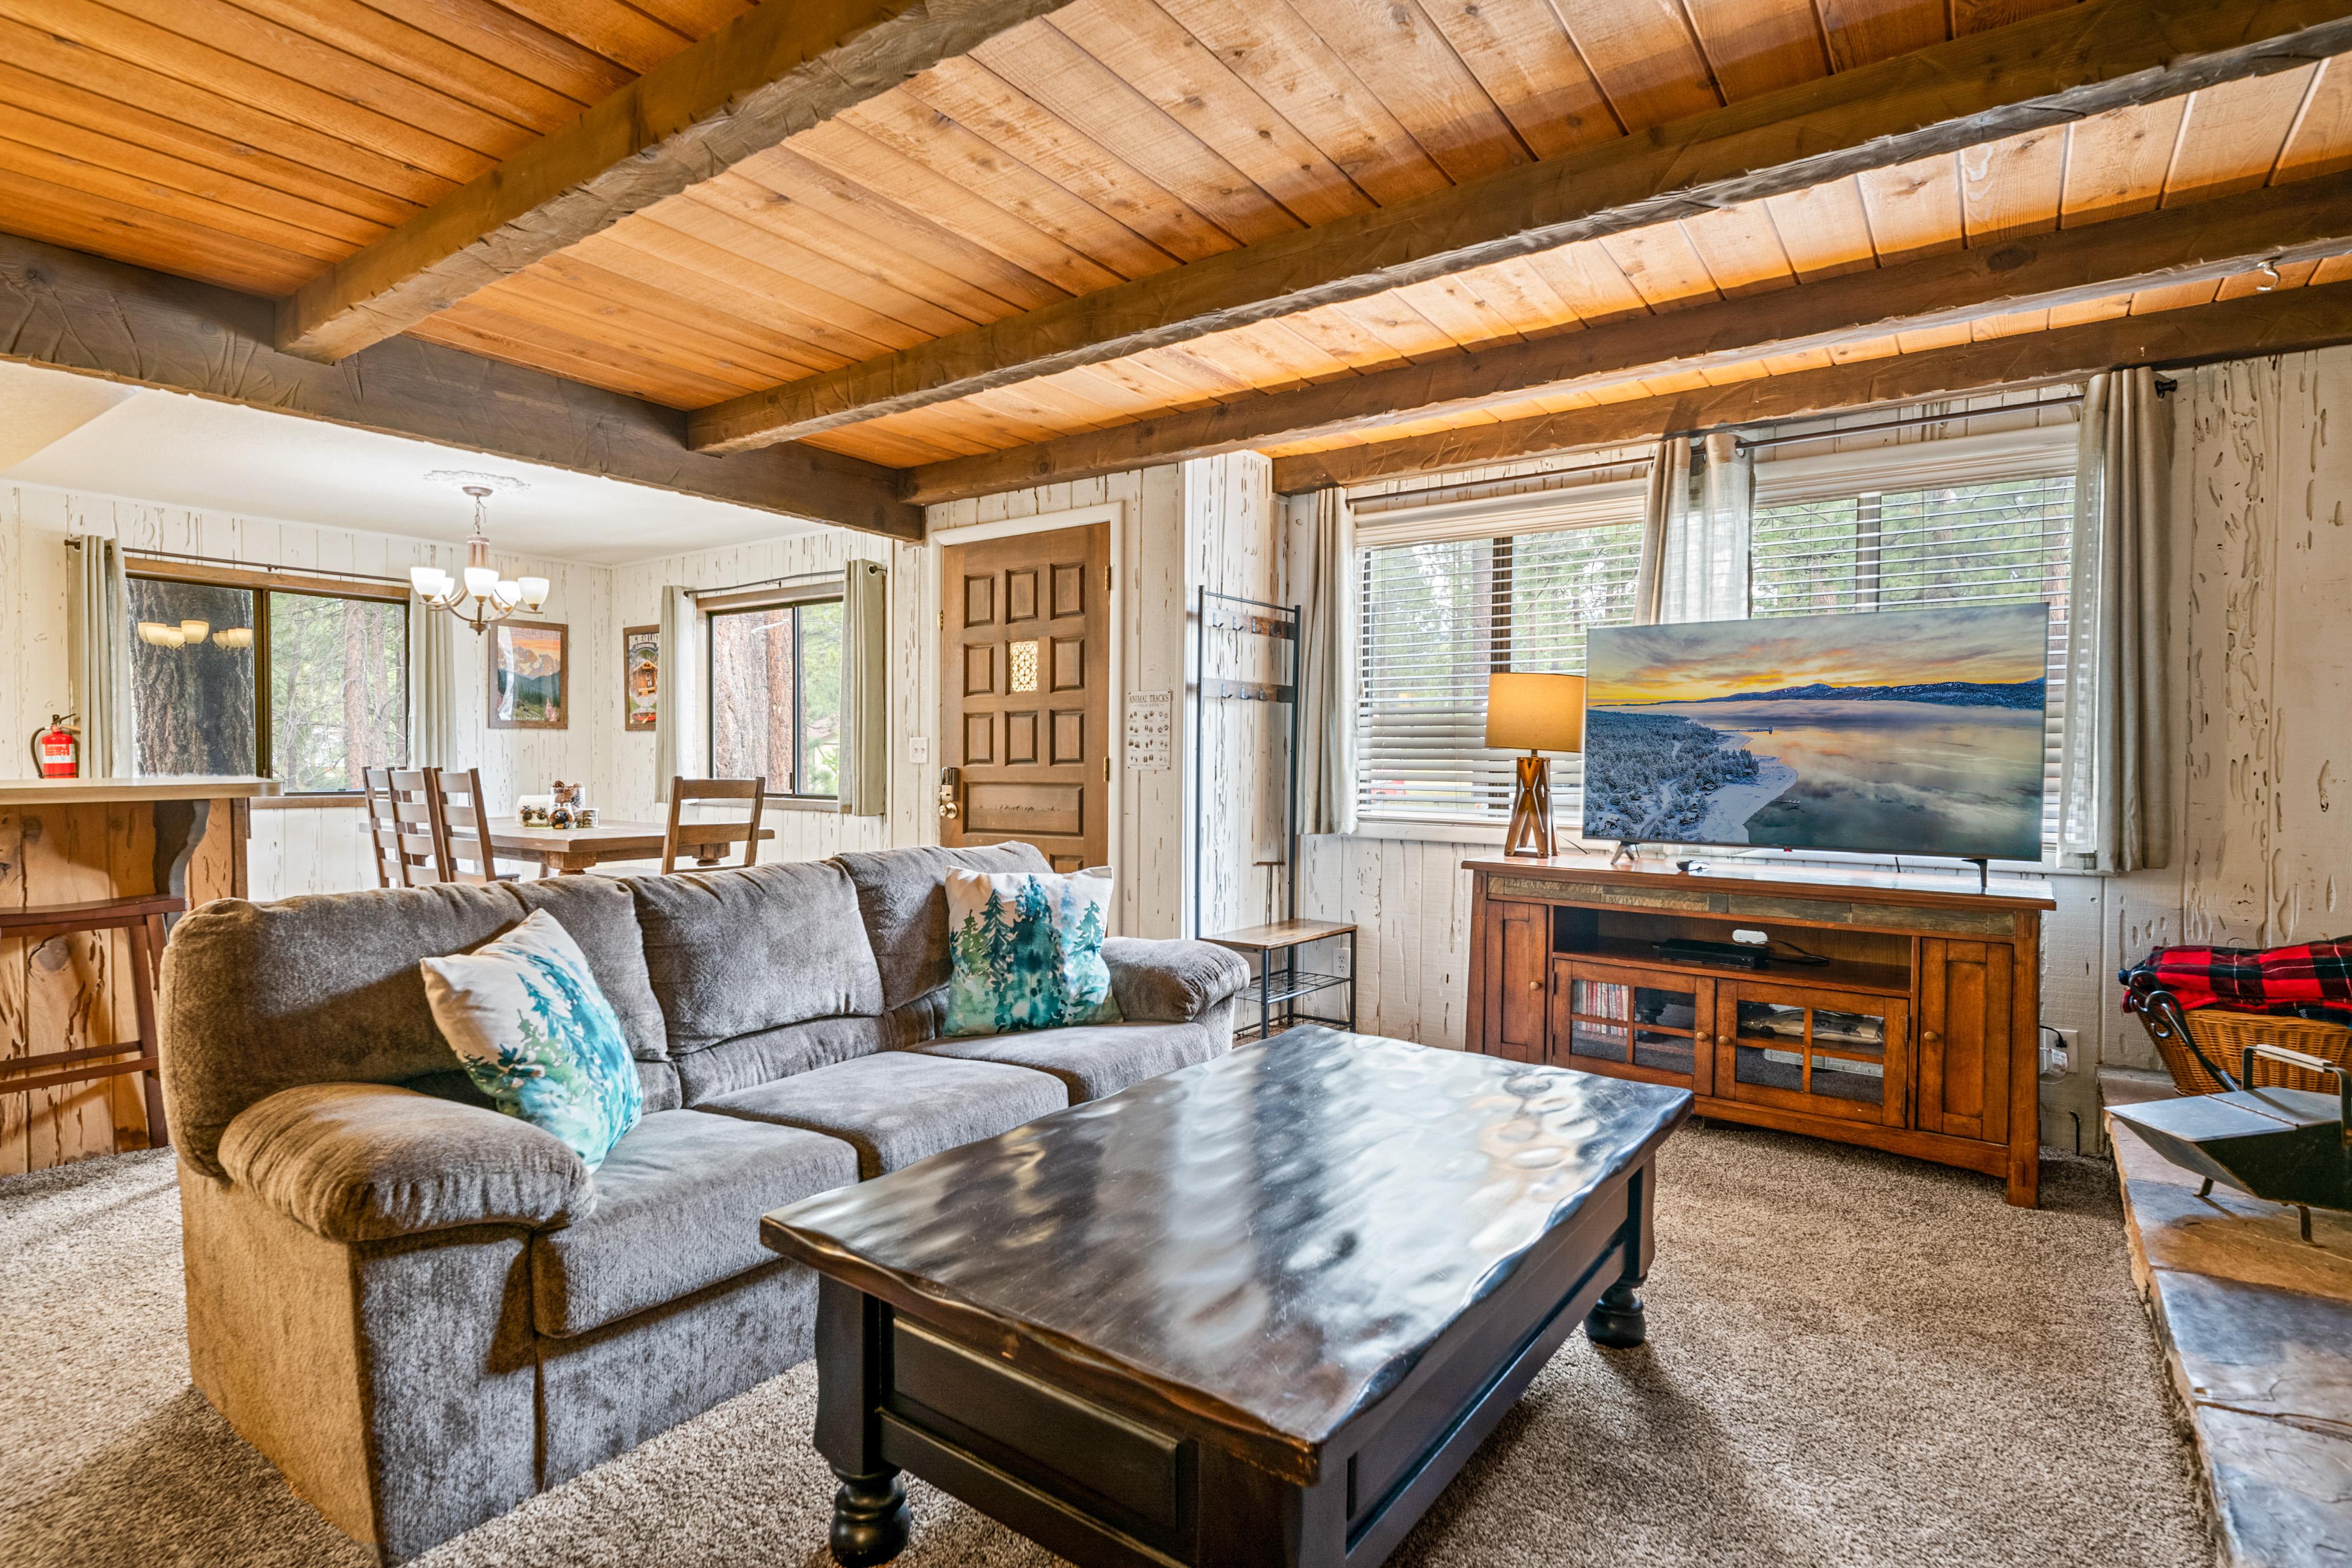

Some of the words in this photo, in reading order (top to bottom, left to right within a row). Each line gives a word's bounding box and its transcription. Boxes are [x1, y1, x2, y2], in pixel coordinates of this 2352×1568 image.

[516, 628, 537, 638] BEAR
[637, 634, 649, 643] BEAR
[1149, 694, 1169, 703] TRACKS
